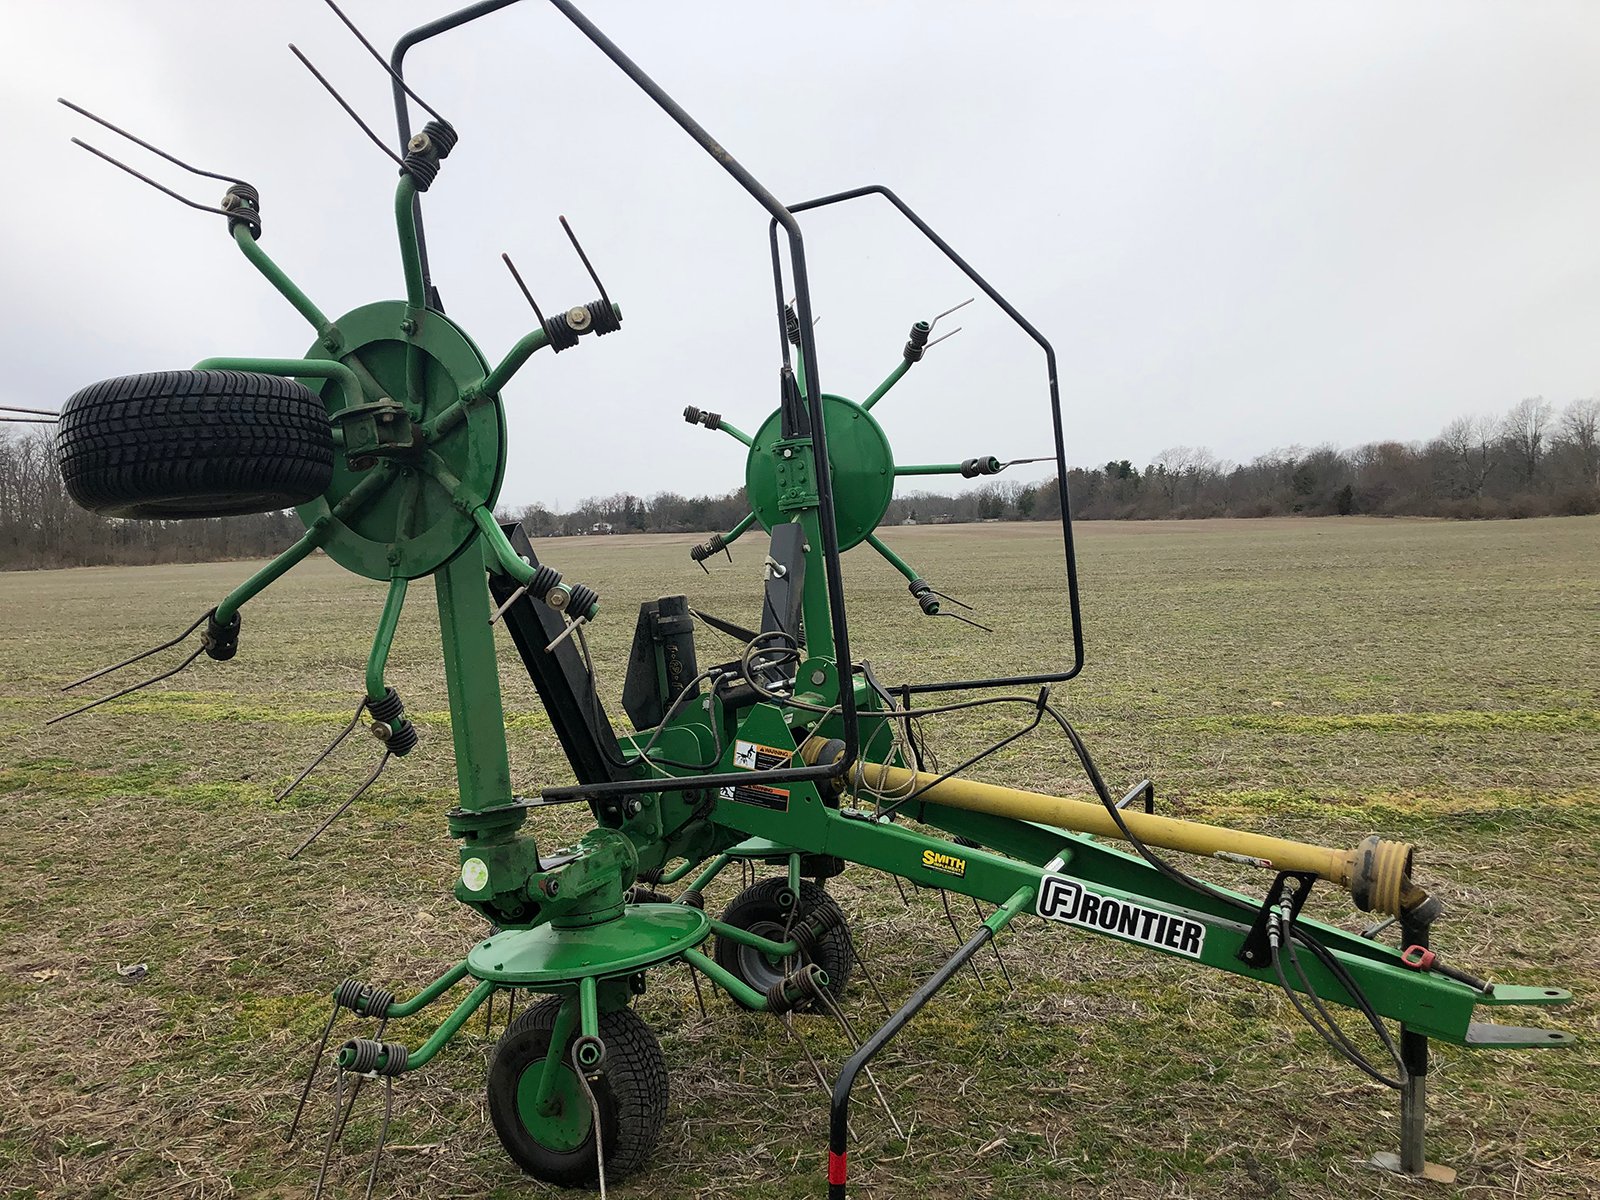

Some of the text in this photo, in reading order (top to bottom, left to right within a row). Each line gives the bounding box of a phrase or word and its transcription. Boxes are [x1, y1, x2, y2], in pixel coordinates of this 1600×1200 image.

[765, 748, 789, 757] WARNING
[922, 850, 966, 870] SMITH
[1039, 876, 1203, 954] FRONTIER
